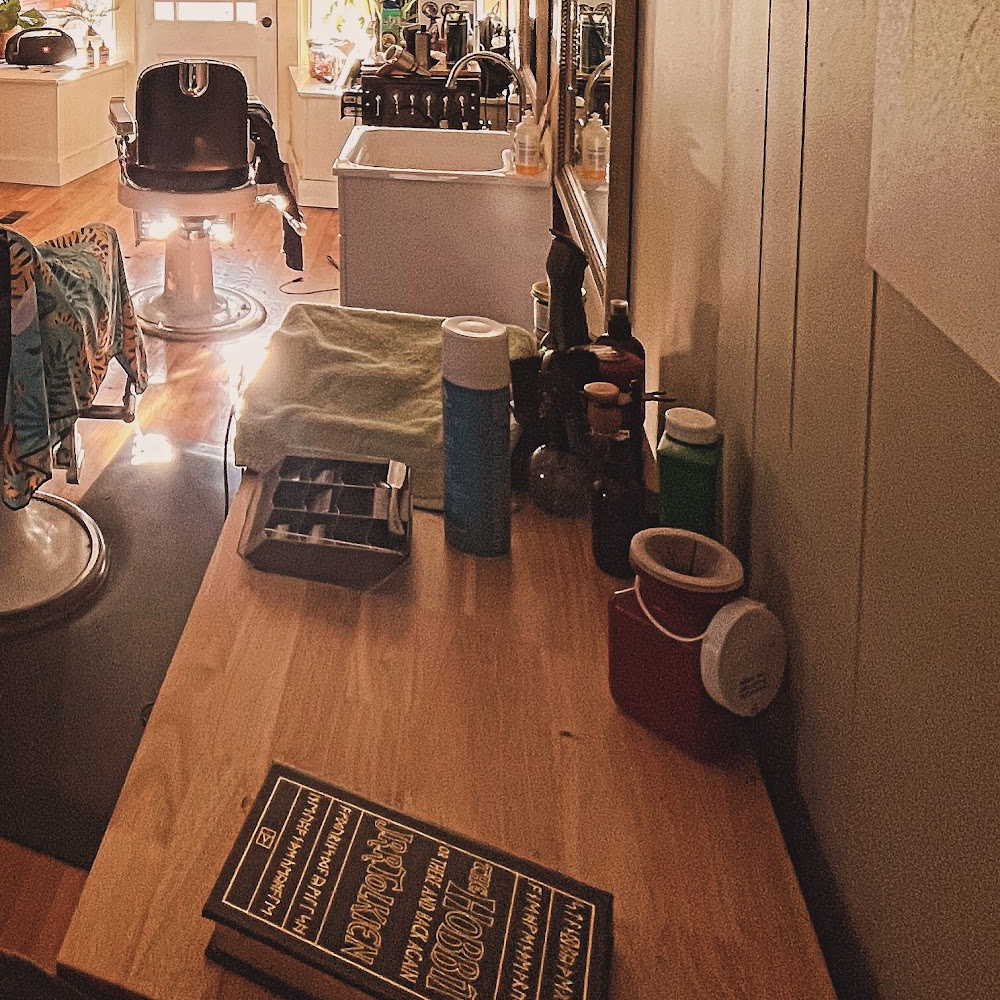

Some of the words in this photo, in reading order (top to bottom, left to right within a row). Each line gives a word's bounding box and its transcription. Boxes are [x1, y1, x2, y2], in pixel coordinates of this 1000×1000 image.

[437, 845, 450, 858] OR
[424, 857, 448, 889] THERE
[418, 886, 438, 912] AND
[410, 911, 433, 943] BACK
[399, 940, 423, 984] AGAIN
